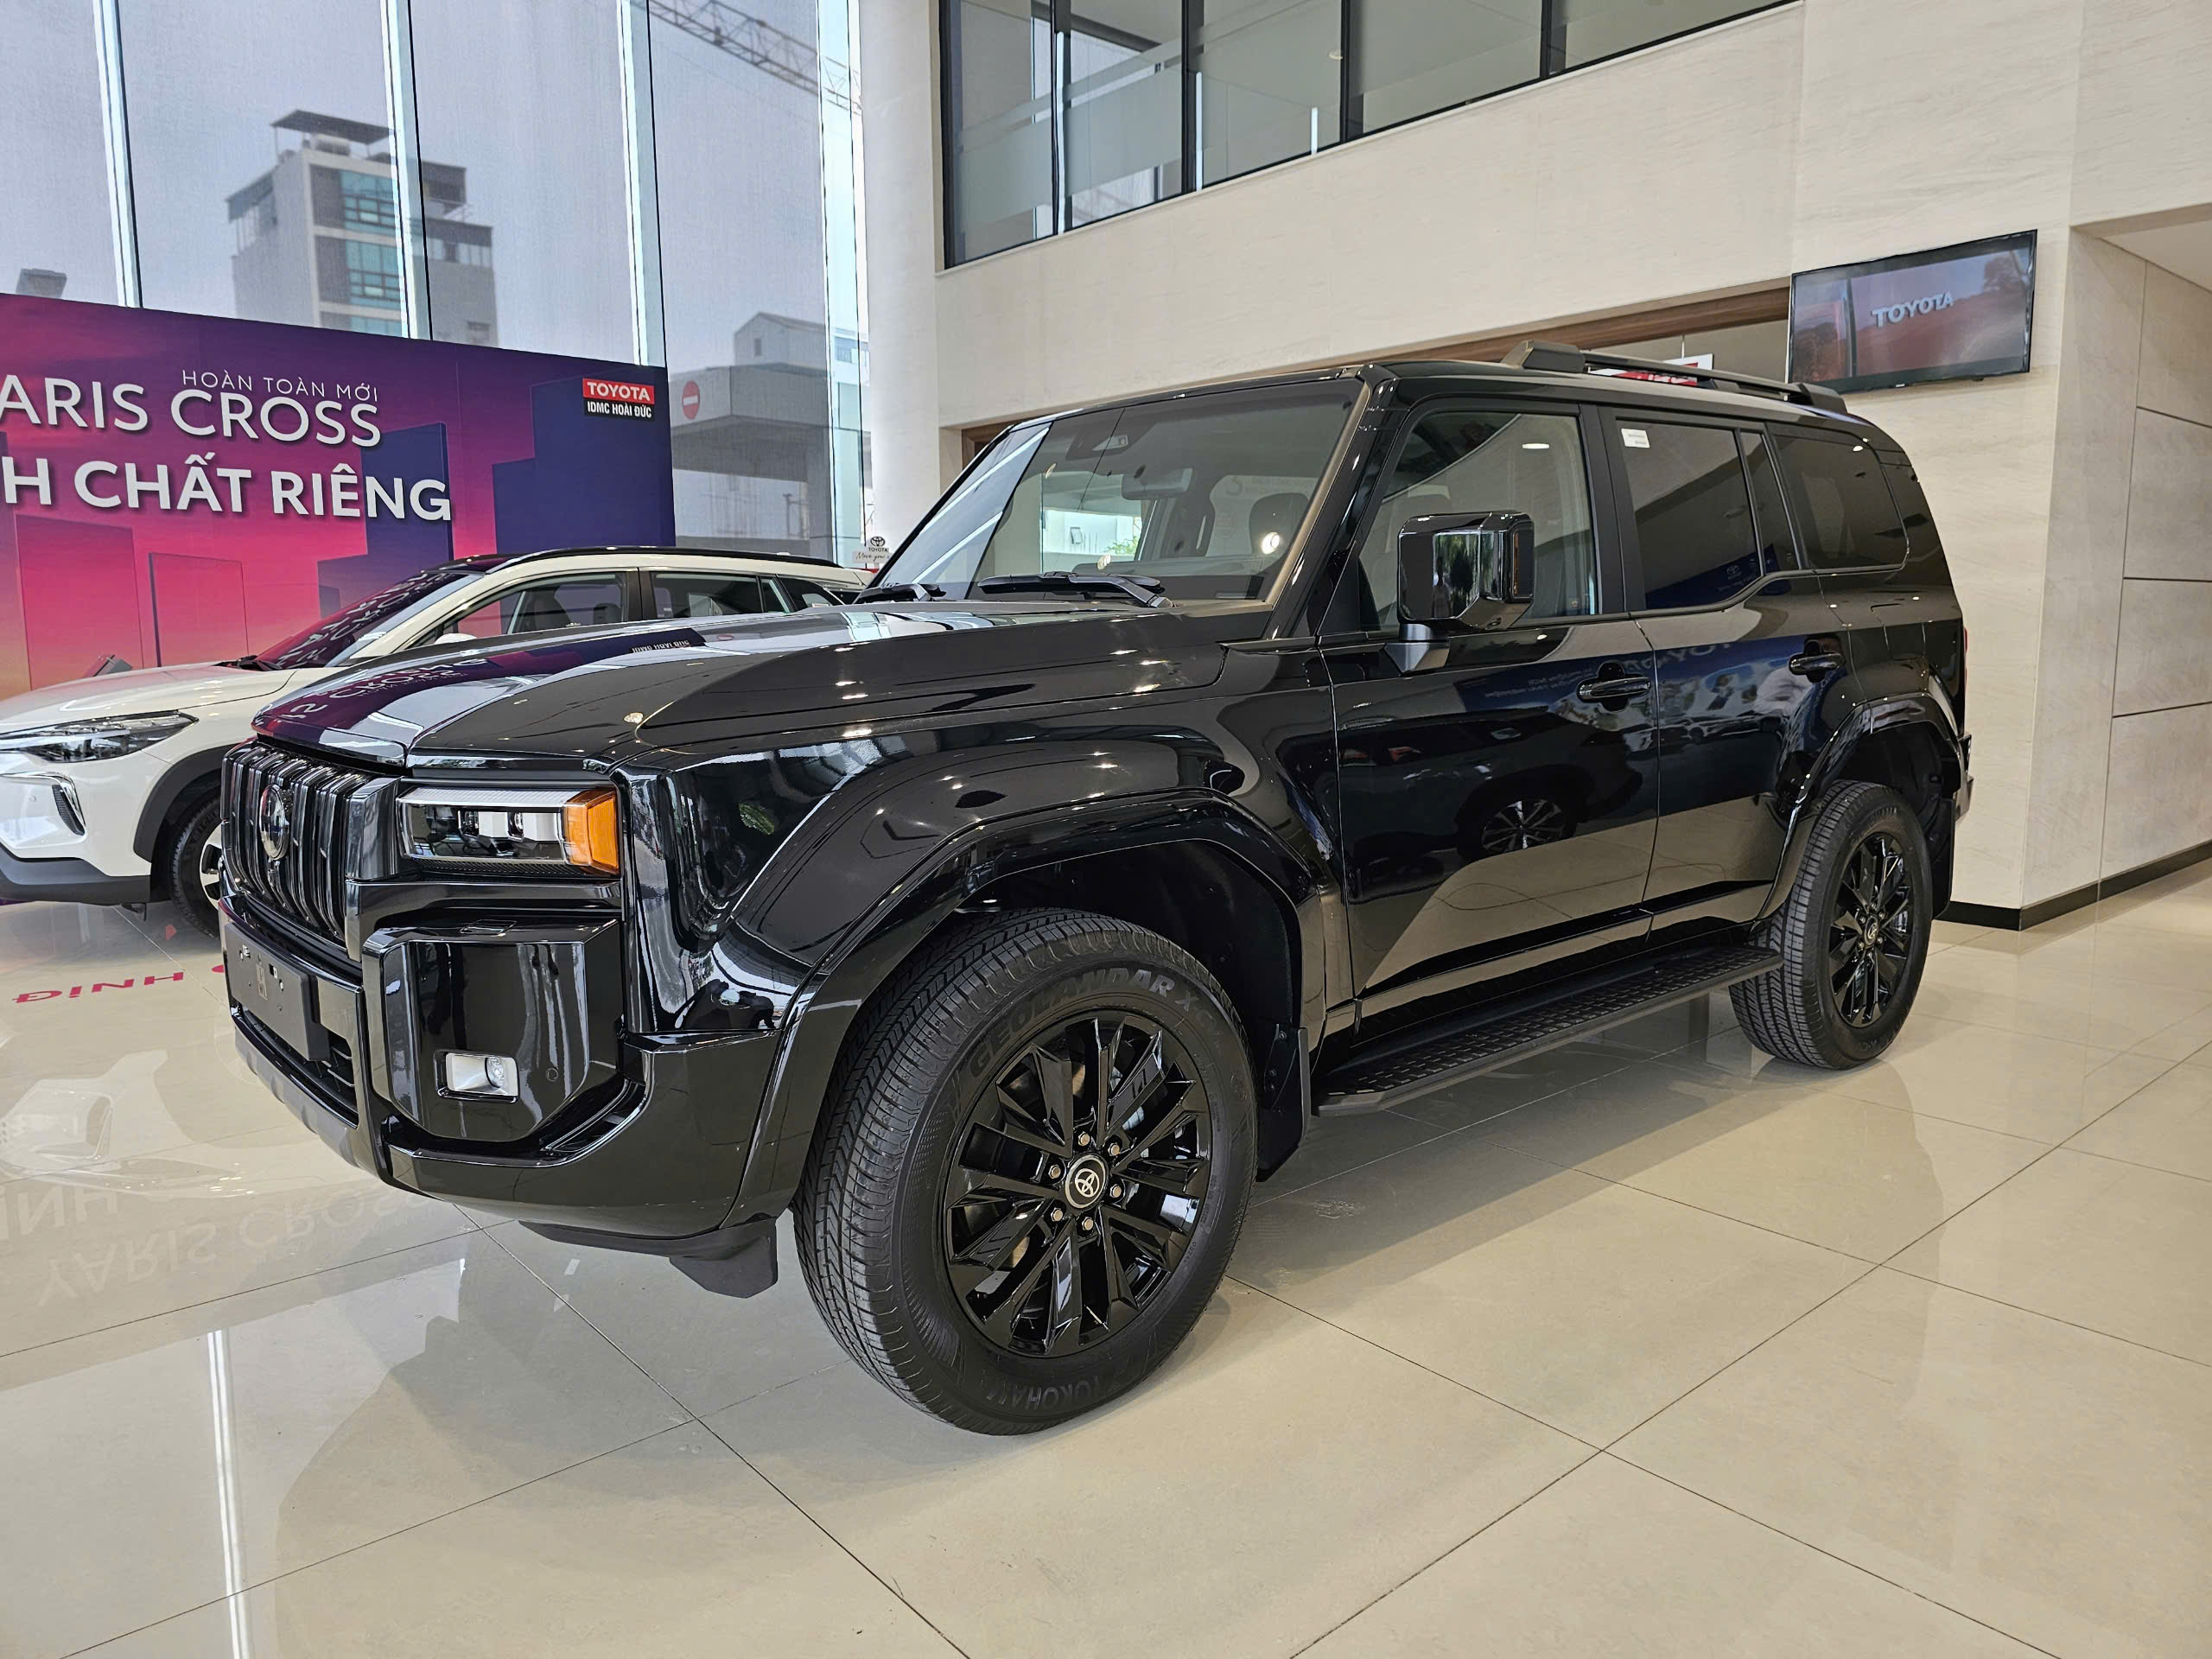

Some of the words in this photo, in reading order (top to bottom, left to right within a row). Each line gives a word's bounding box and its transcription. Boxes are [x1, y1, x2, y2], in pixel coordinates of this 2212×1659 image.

[1872, 292, 1954, 328] TOYOTA
[182, 370, 252, 391] HOÀN
[263, 377, 325, 397] TOÀN
[336, 383, 378, 402] MỚI
[587, 382, 650, 400] TOYOTA
[171, 389, 381, 447] CROSS
[588, 401, 610, 414] IDMC
[612, 403, 632, 416] HOÀI
[633, 404, 652, 418] ĐỨC
[74, 452, 251, 512] CHẤT
[270, 463, 451, 521] RIÊNG
